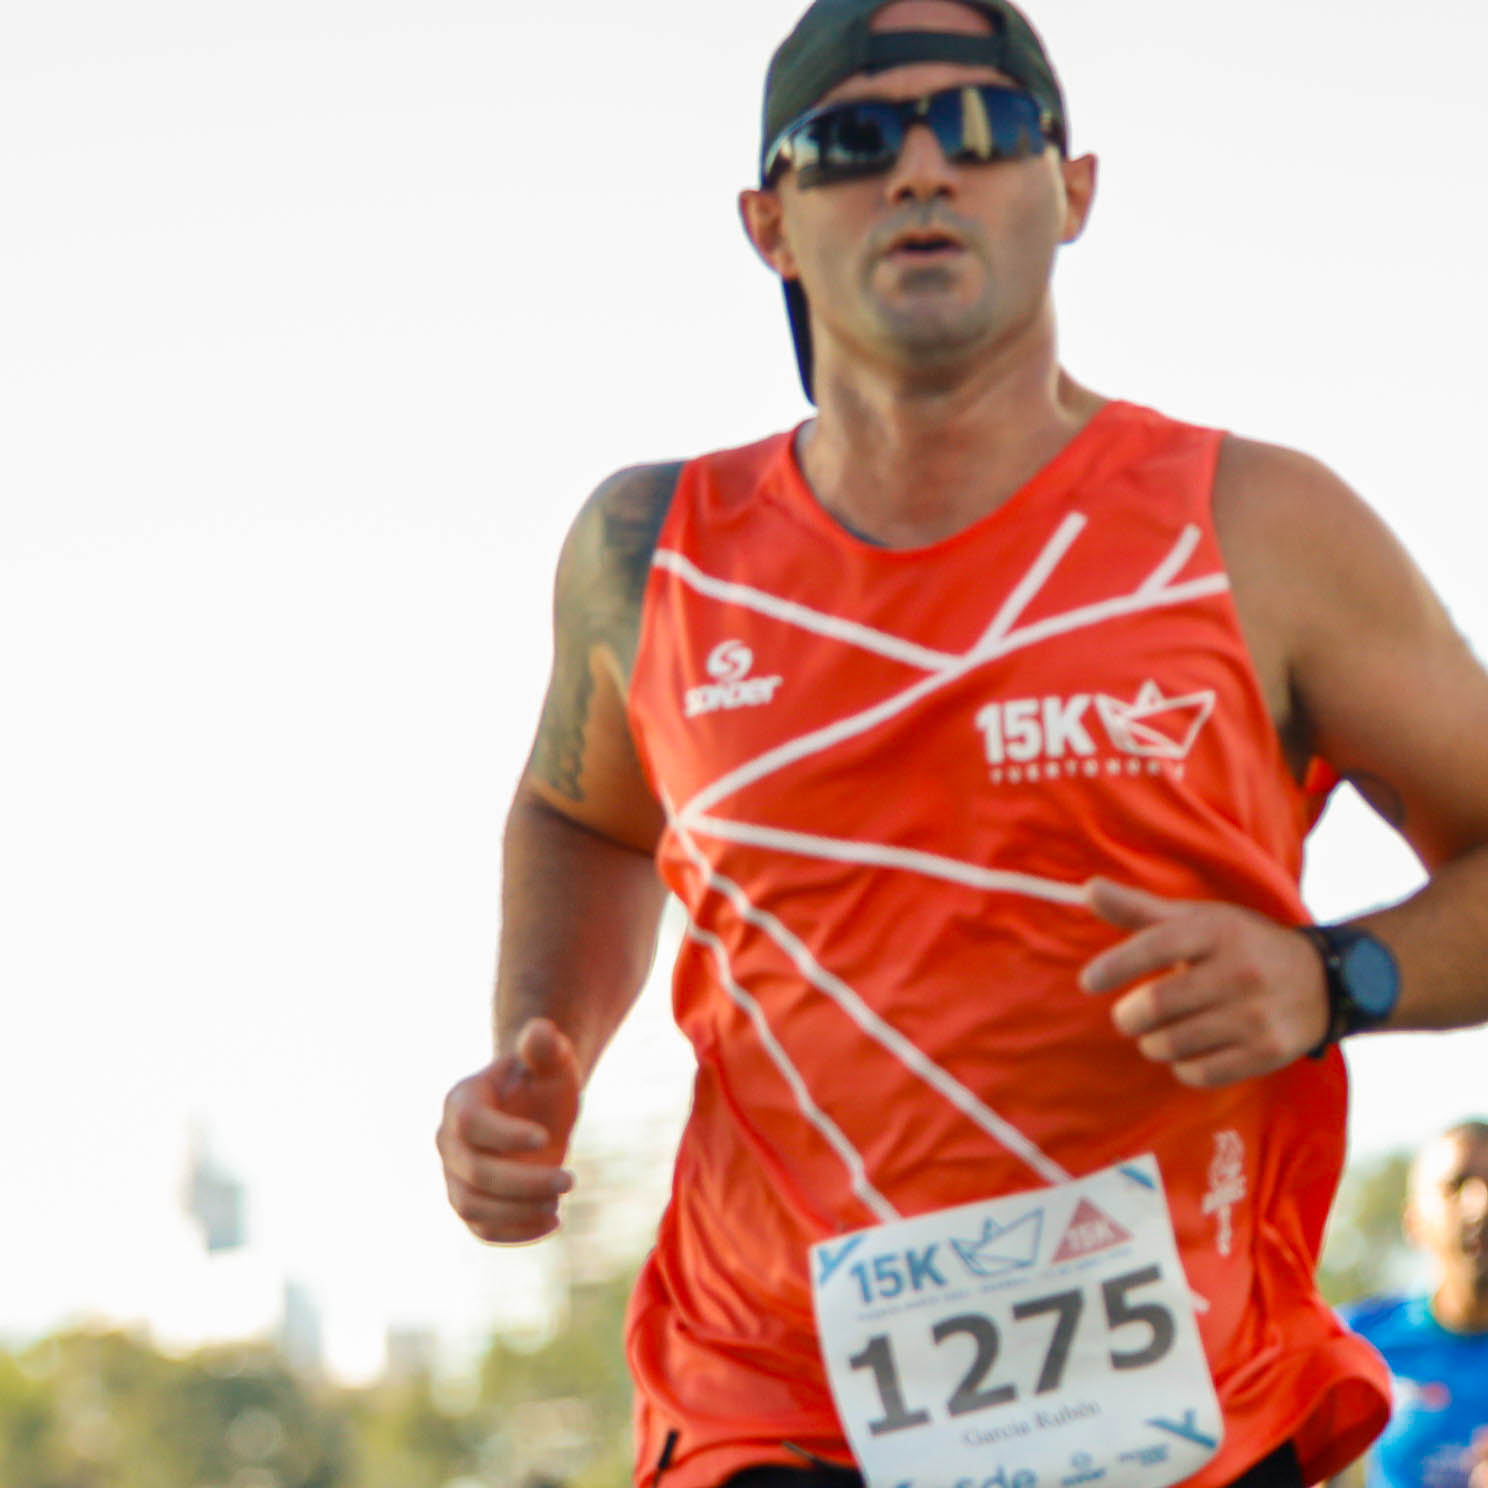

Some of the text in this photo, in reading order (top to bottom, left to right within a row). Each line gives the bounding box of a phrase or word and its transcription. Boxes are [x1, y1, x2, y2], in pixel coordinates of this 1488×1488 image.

[975, 693, 1097, 765] 15K
[850, 1243, 948, 1304] 15K
[848, 1265, 1177, 1437] 1275
